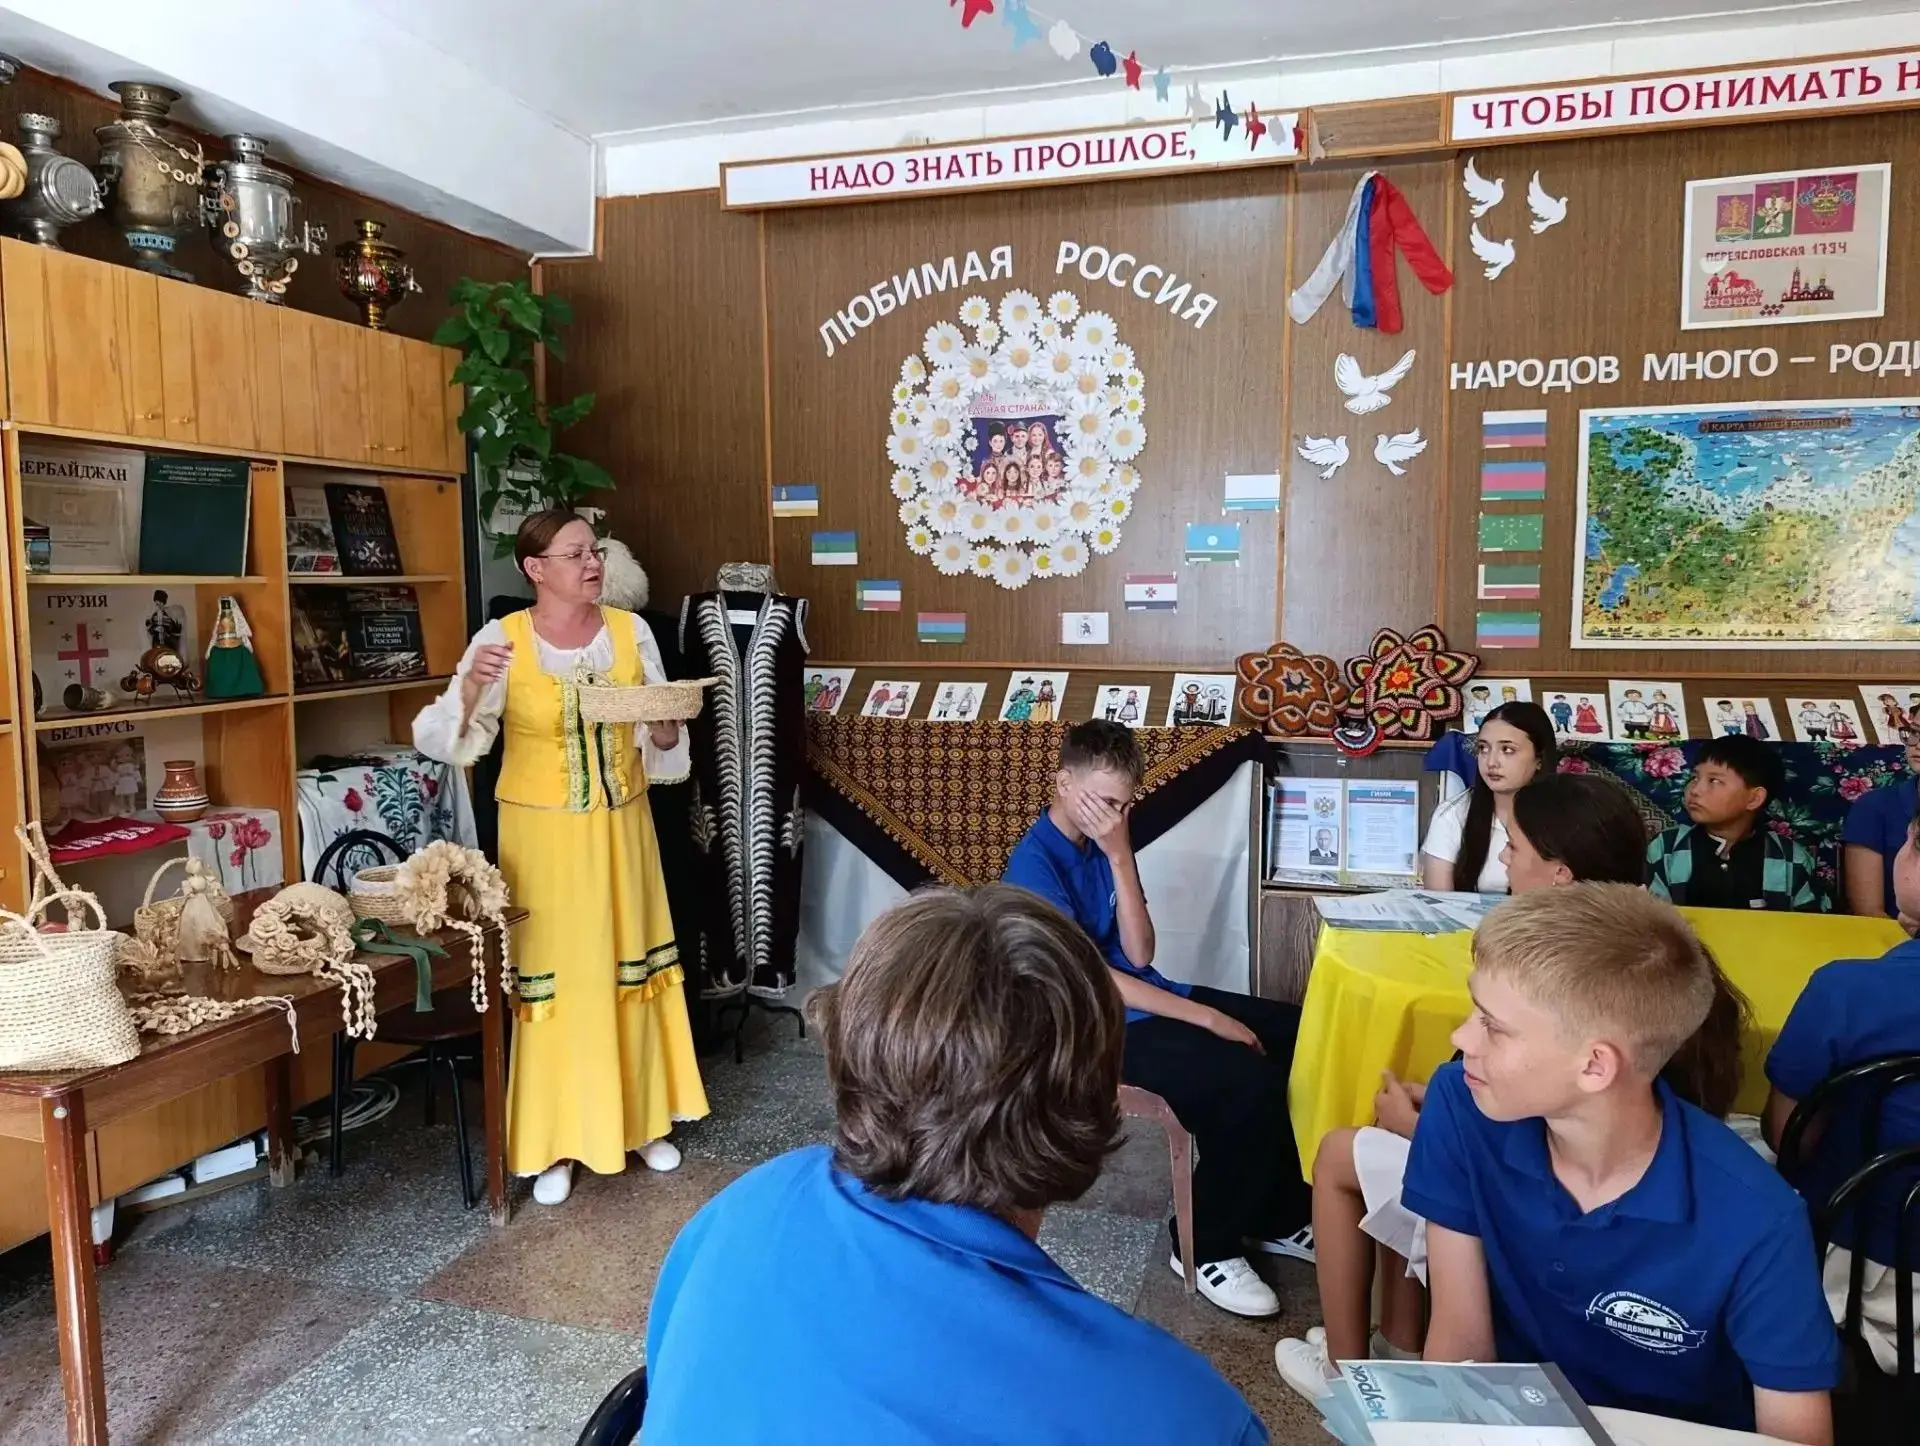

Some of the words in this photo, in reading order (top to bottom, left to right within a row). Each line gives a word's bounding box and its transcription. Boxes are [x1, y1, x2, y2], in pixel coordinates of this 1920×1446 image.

[1472, 89, 1614, 130] ЧТОБЫ
[1629, 66, 1883, 116] ПОНИМАТЬ
[810, 161, 895, 191] НАДО
[905, 151, 1004, 184] ЗНАТЬ
[1014, 131, 1196, 173] ПРОШЛОЕ,
[1812, 242, 1848, 255] 1794
[818, 244, 1014, 358] ЛЮБИМАЯ
[1055, 240, 1219, 330] РОССИЯ
[1450, 355, 1620, 395] НАРОДОВ
[1643, 347, 1779, 381] МНОГО
[1829, 340, 1920, 377] РОД
[1712, 421, 1745, 431] КАРТА
[47, 594, 108, 609] ГРУЗИЯ
[50, 719, 136, 742] БЕЛАРУСЬ
